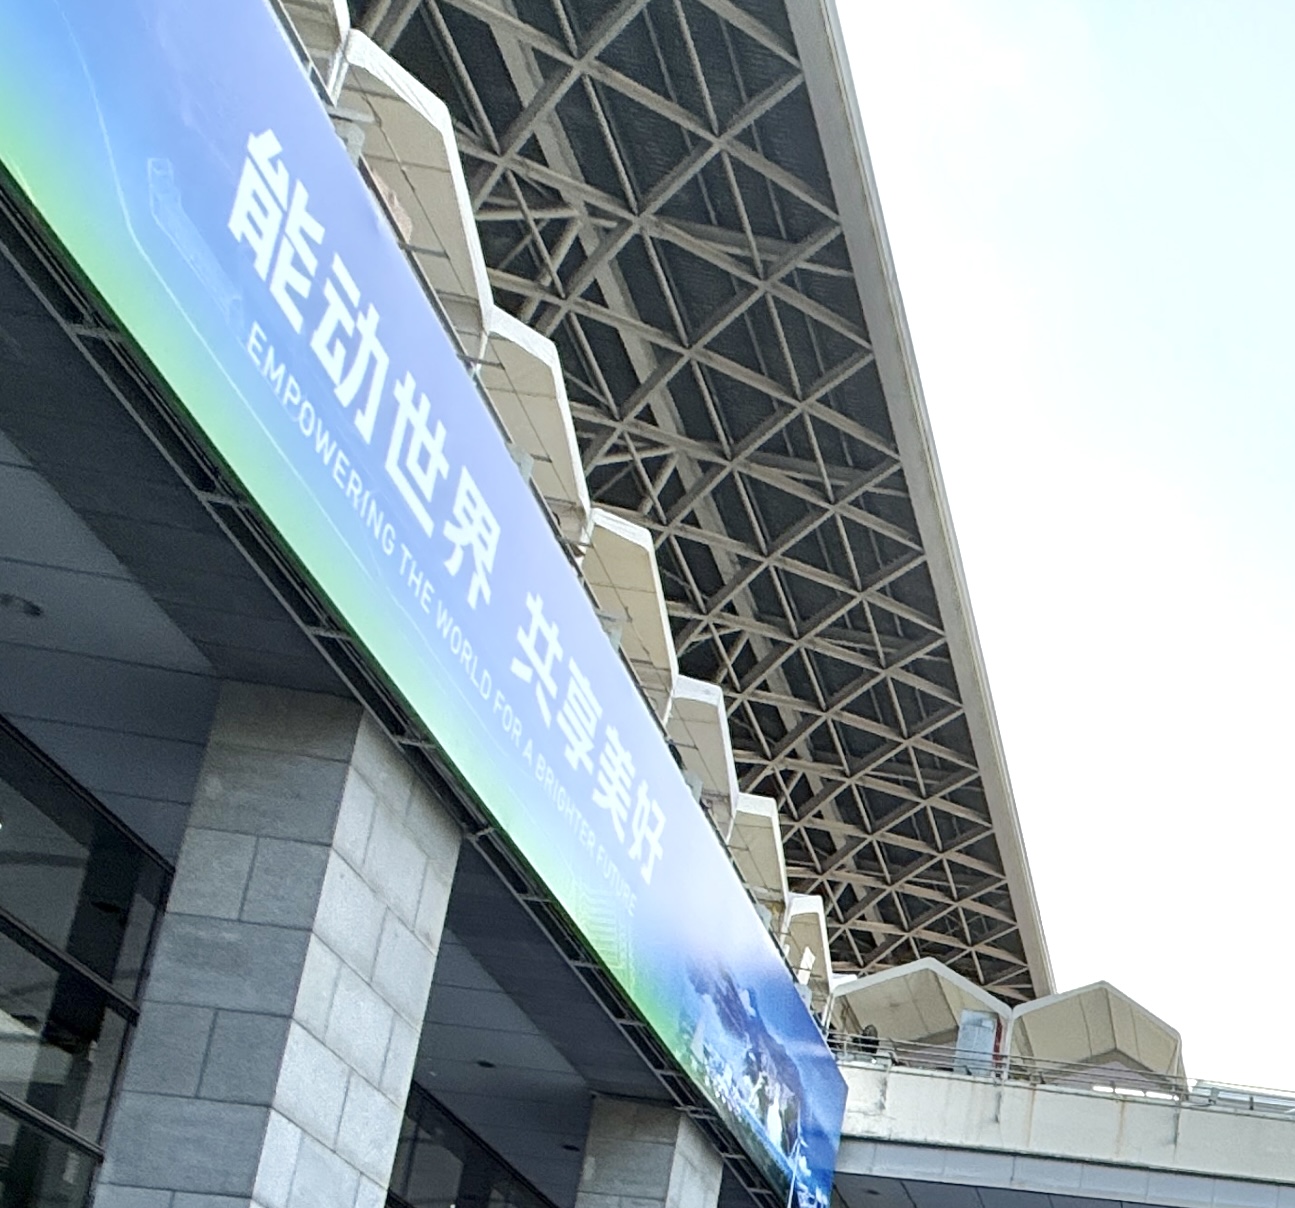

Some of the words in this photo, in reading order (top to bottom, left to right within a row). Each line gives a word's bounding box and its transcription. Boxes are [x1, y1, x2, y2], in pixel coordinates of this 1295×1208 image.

[228, 128, 501, 610] 能动世界
[510, 590, 666, 886] 共享美好
[247, 319, 396, 556] EMPOWERING
[400, 543, 435, 615] THE
[436, 598, 492, 700] WORLD
[493, 689, 523, 748] FOR
[522, 737, 533, 767] A
[535, 752, 596, 858] BRIGHTER
[596, 844, 638, 917] FUTURE
